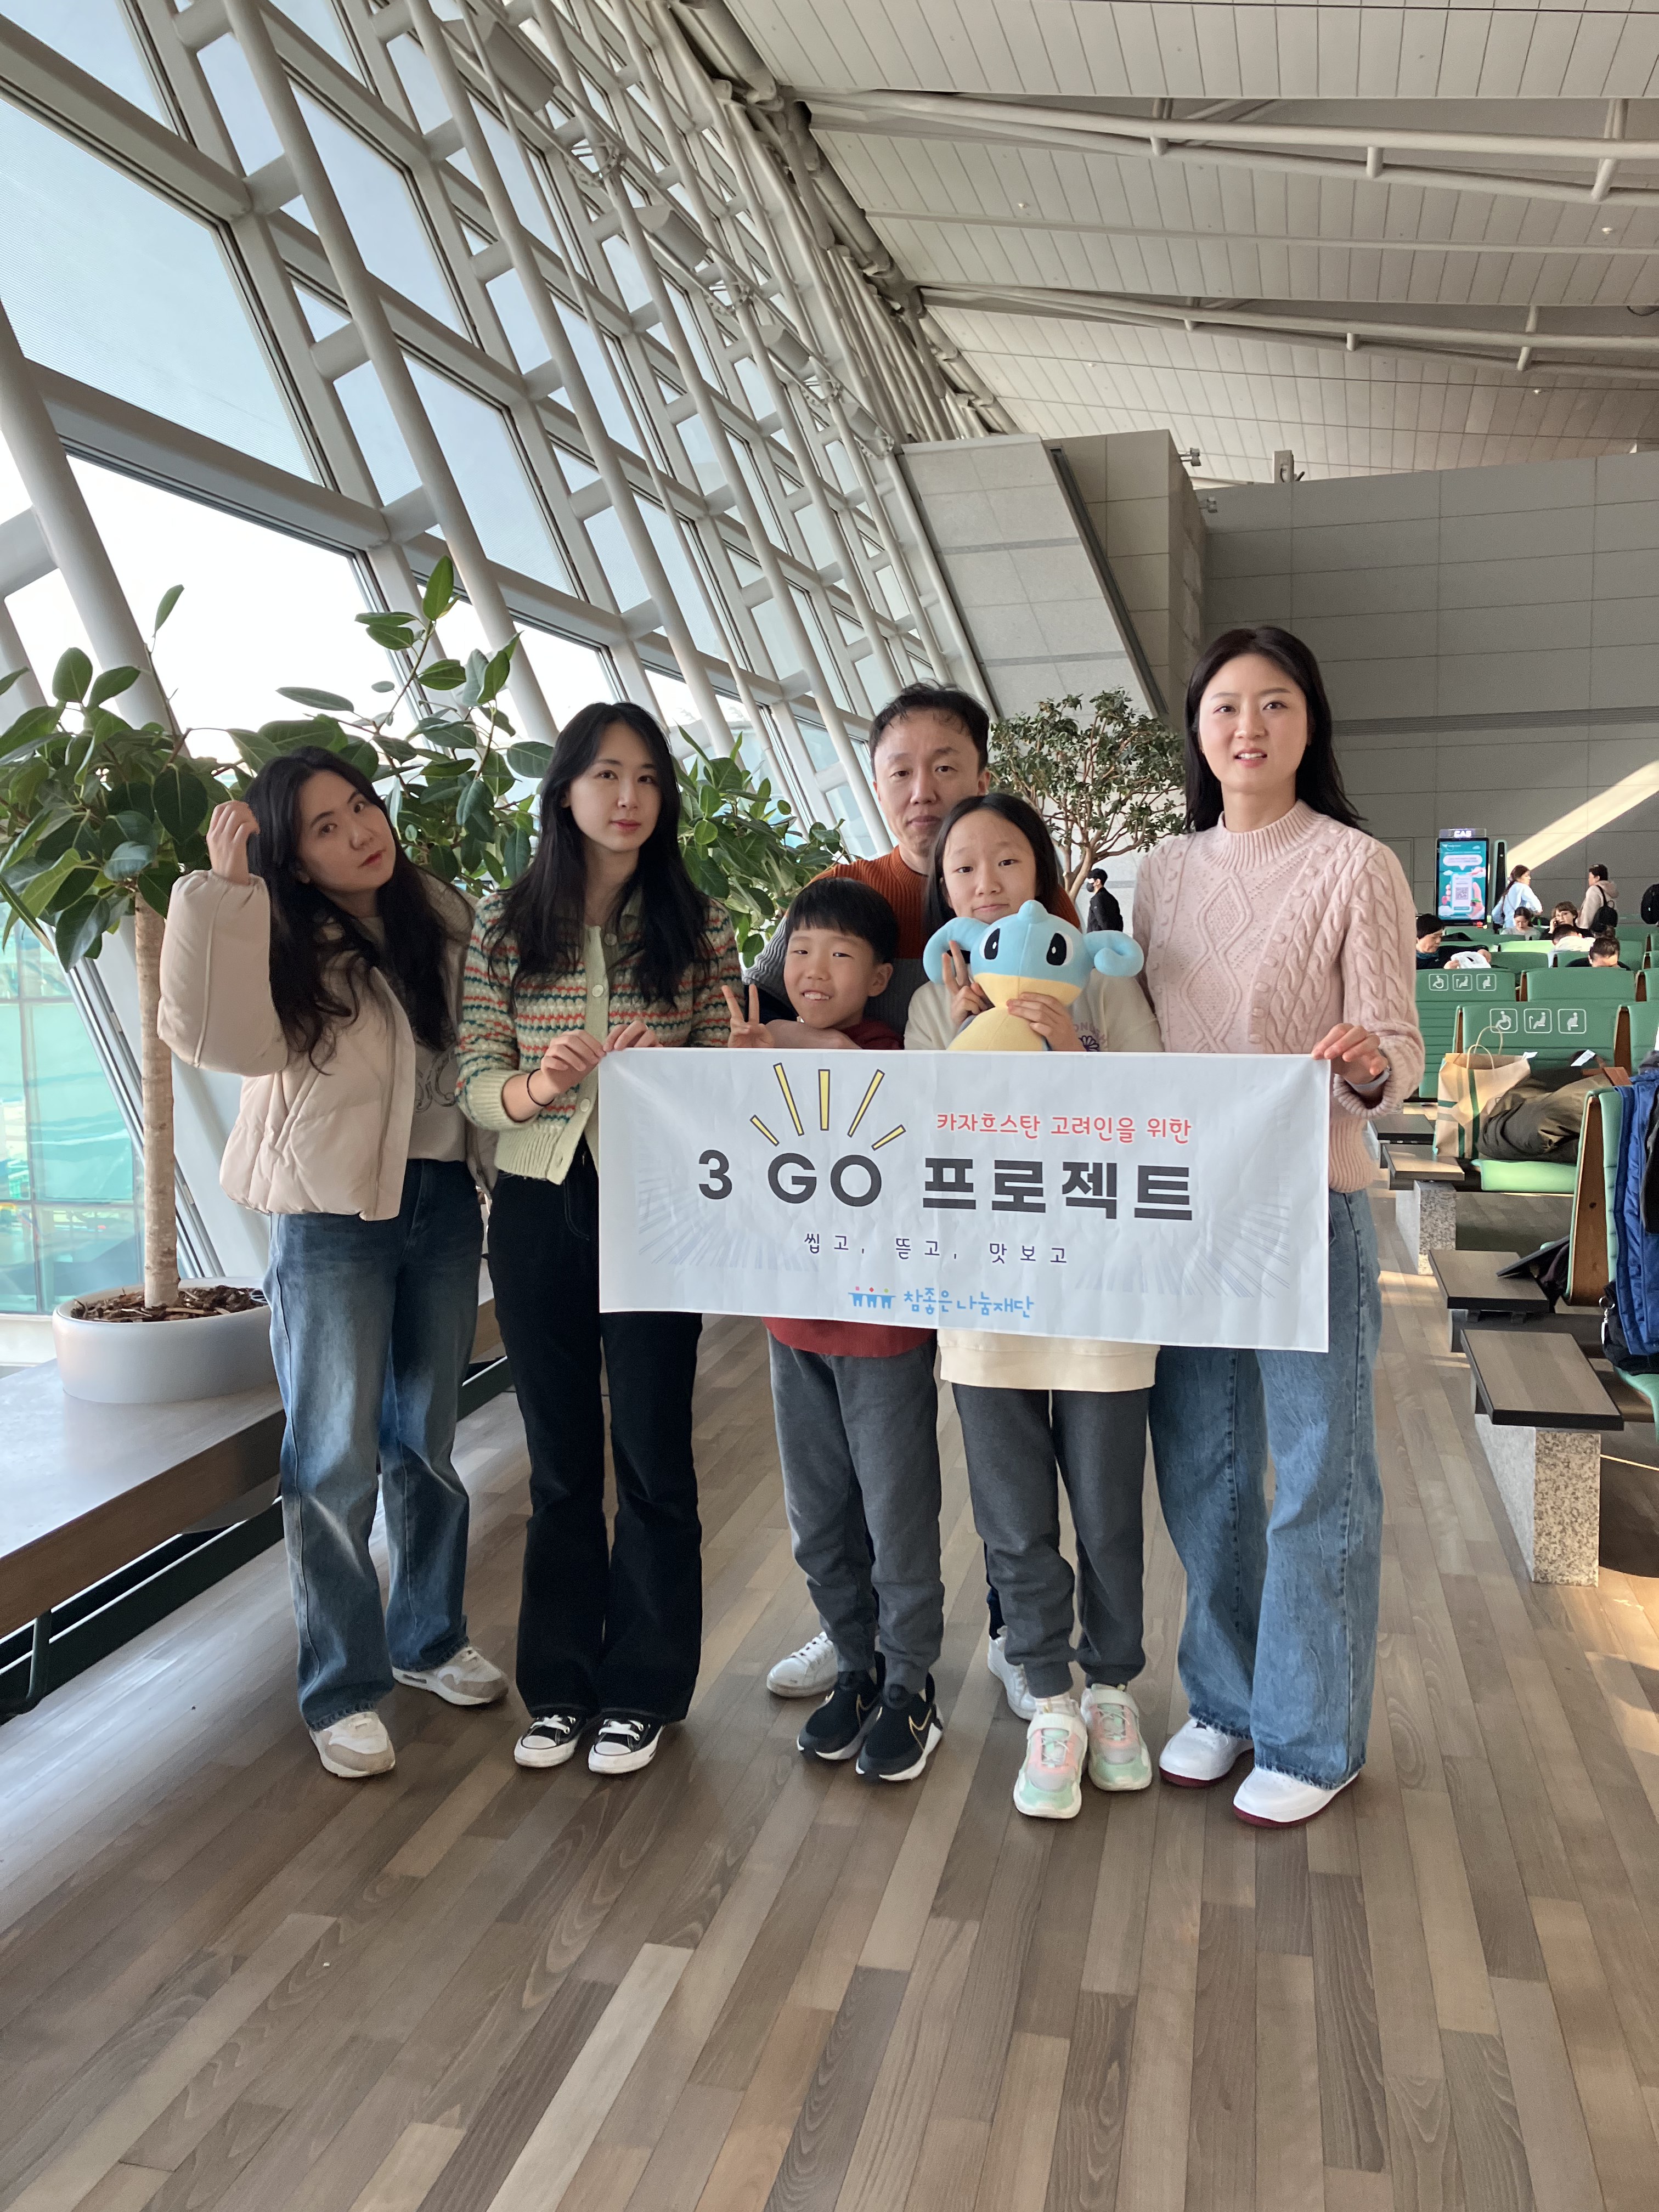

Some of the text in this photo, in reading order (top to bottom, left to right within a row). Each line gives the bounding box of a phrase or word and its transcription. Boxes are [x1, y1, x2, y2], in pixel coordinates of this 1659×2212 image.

[937, 1113, 1192, 1144] 카자흐스탄 고려인을 위한
[698, 1149, 1193, 1221] 3 GO 프로젝트
